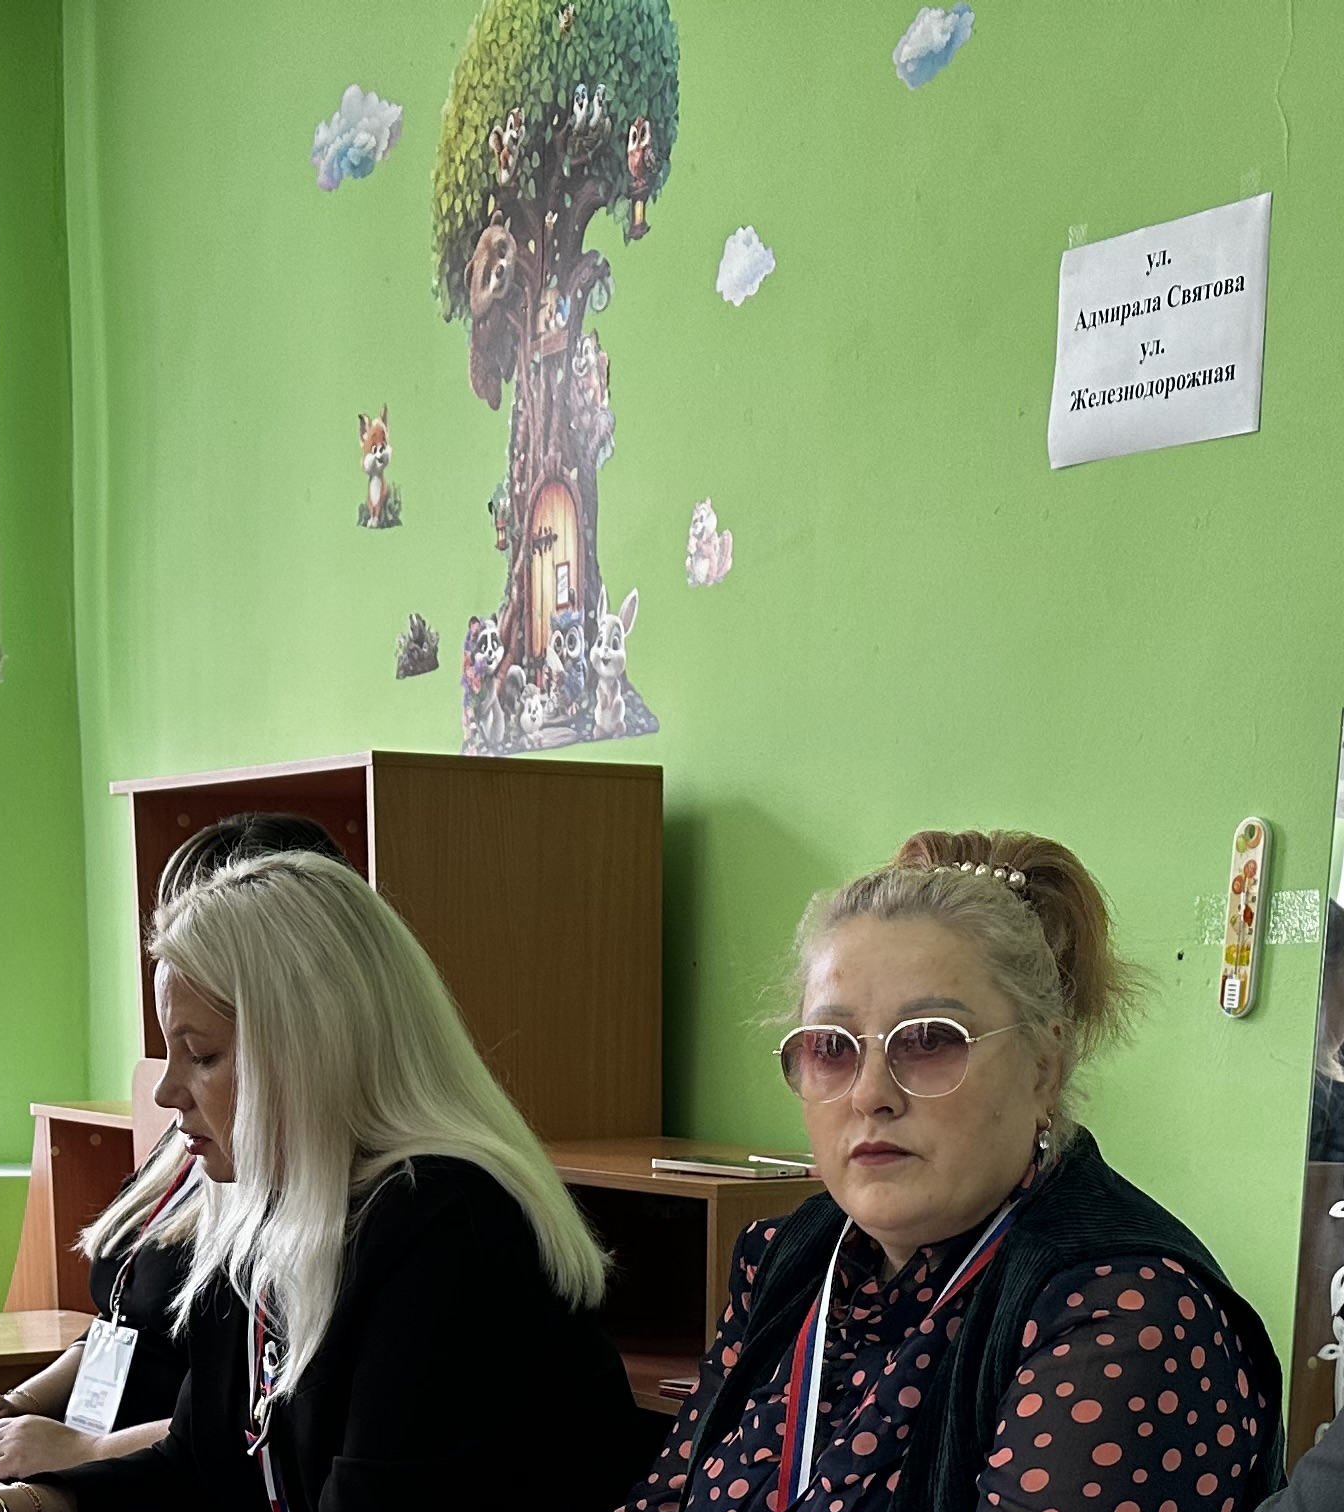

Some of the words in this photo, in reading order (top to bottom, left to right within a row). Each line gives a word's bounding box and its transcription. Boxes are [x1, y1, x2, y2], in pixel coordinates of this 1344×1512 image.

[1146, 248, 1172, 275] ул.
[1075, 295, 1160, 332] Адмирала
[1167, 272, 1246, 309] Святова
[1139, 339, 1165, 364] ул.
[1069, 362, 1236, 413] Железнодорожная
